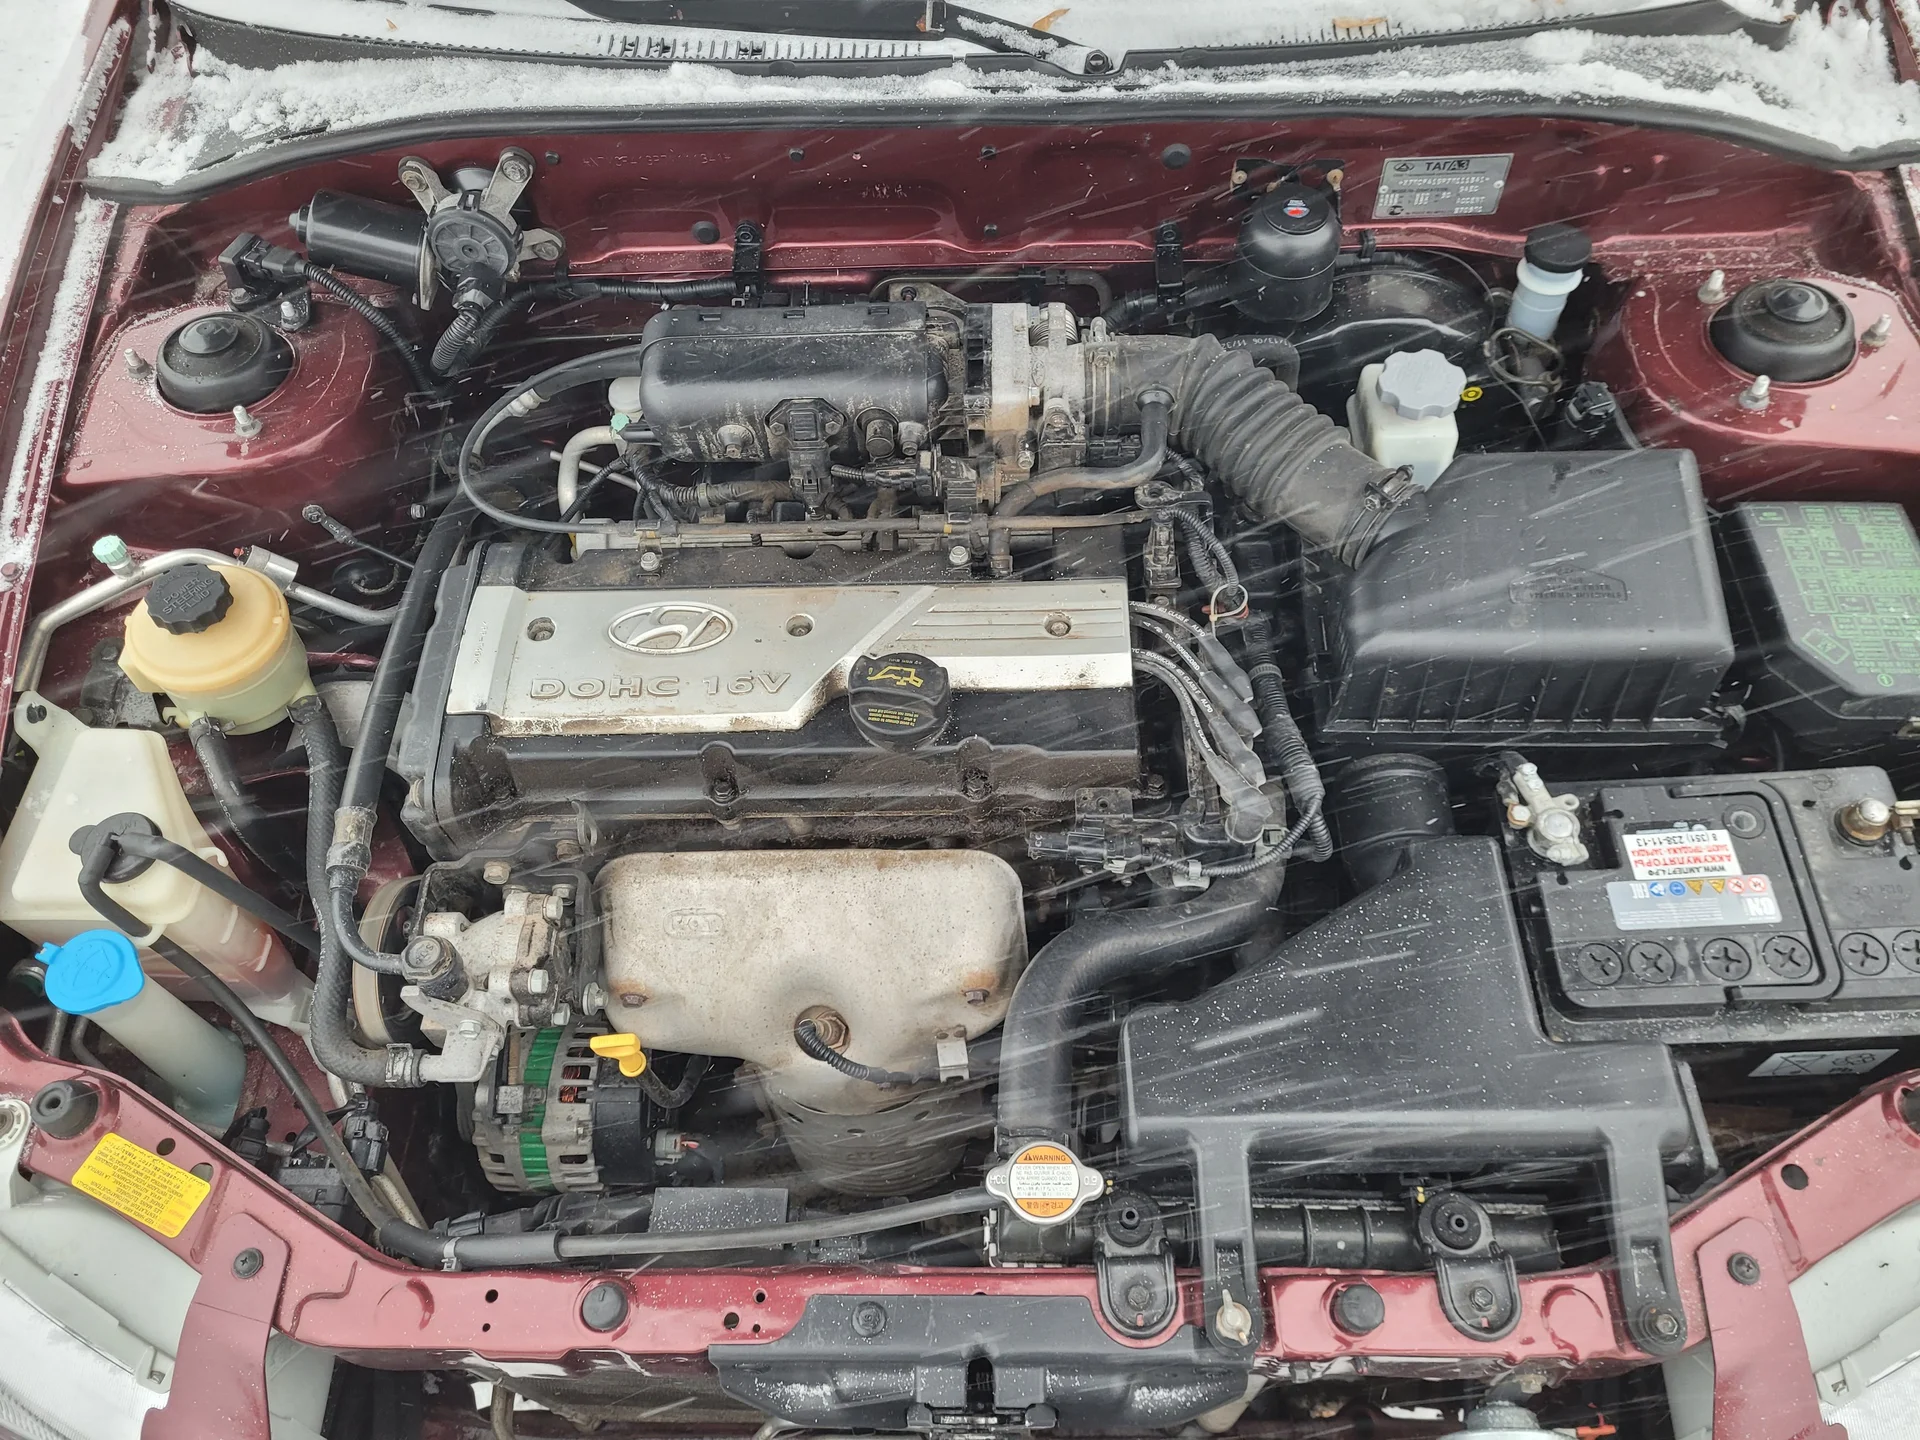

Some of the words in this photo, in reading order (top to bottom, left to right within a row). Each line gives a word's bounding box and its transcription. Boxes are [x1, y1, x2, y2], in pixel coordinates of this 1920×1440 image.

[1426, 160, 1470, 171] ТАГАЗ
[162, 578, 214, 615] STEERING
[163, 577, 200, 604] POWER
[180, 589, 210, 612] FLUID
[529, 676, 681, 699] DOHC
[702, 671, 792, 695] 16V
[1687, 833, 1710, 843] (351)
[1633, 854, 1732, 868] АККУМУЛЯТОРЫ
